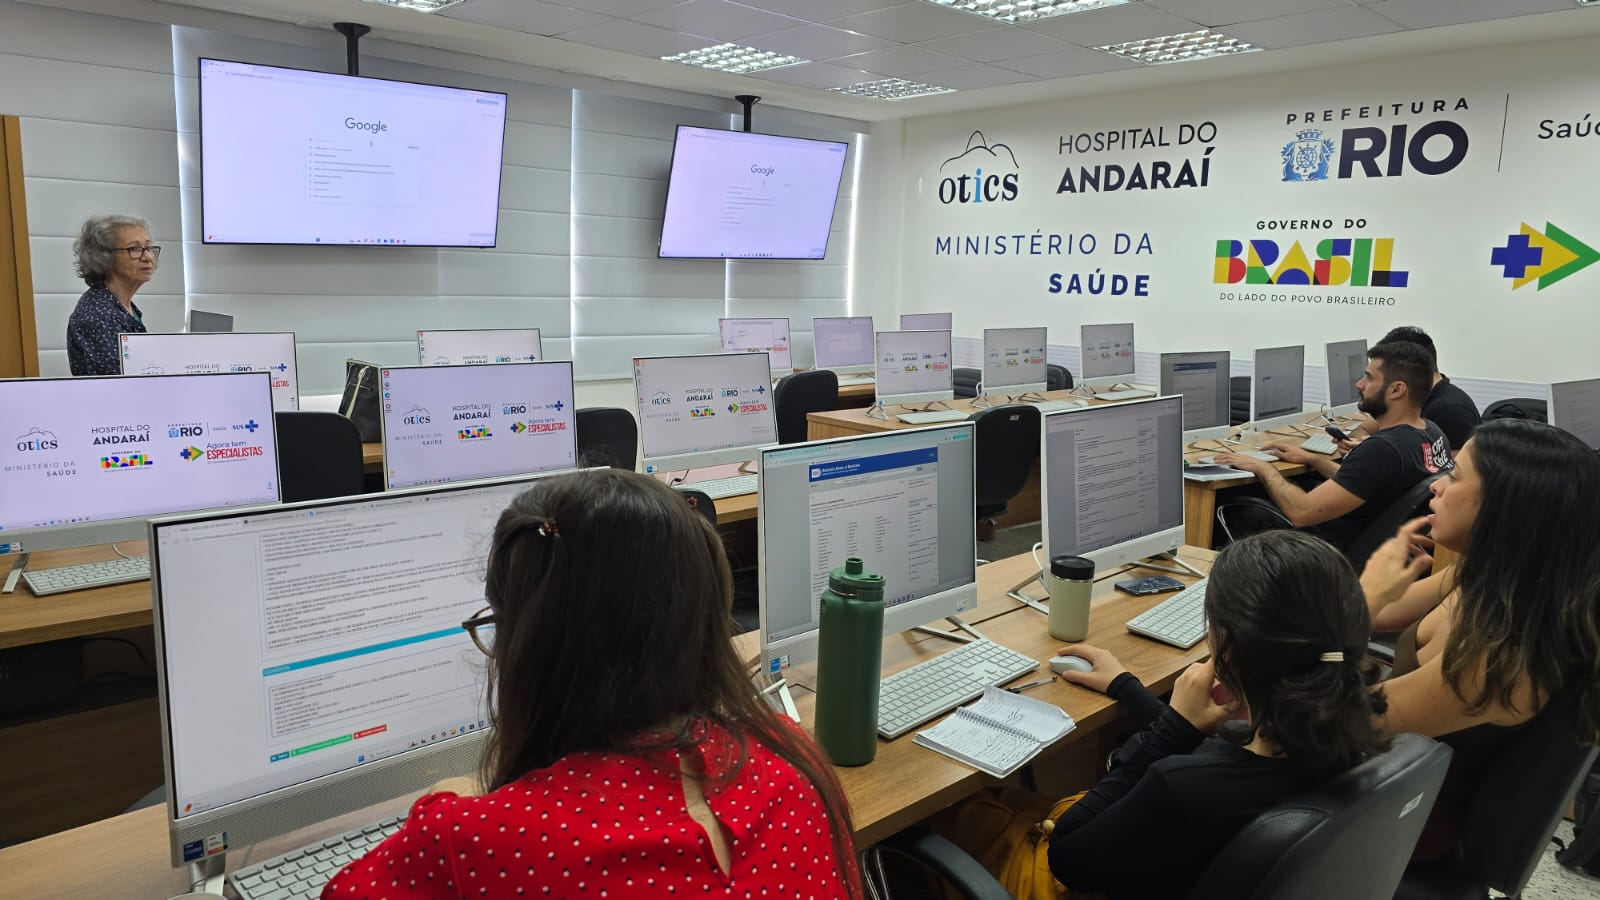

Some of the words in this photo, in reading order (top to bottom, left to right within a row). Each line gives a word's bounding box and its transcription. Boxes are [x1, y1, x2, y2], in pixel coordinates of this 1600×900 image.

[1286, 97, 1469, 125] PREFEITURA
[345, 117, 387, 134] Google
[1059, 127, 1170, 154] HOSPITAL
[1178, 121, 1217, 145] DO
[1338, 120, 1469, 179] RIO
[750, 164, 775, 176] Google
[1056, 146, 1216, 194] ANDARAÍ
[939, 168, 1019, 204] otics
[1256, 220, 1333, 230] GOVERNO
[1344, 219, 1367, 229] DO
[935, 229, 1097, 255] MINISTÉRIO
[1114, 233, 1152, 255] DA
[1213, 238, 1409, 288] BRASIL
[1048, 268, 1150, 297] SAÚDE
[1220, 292, 1235, 301] DO
[1238, 293, 1267, 302] LADO
[1271, 294, 1287, 302] DO
[1291, 295, 1322, 304] POVO
[1326, 296, 1396, 306] BRASILEIRO
[453, 409, 491, 420] ANDARAÍ
[511, 405, 527, 414] RIO
[403, 415, 431, 425] otics
[91, 425, 135, 434] HOSPITAL
[180, 426, 203, 437] RIO
[528, 422, 566, 433] ESPECIALISTAS
[17, 438, 58, 451] otics
[93, 431, 150, 445] ANDARAÍ
[206, 441, 229, 449] Agora
[206, 446, 263, 460] ESPECIALISTAS
[4, 461, 59, 471] MINISTÉRIO
[100, 454, 153, 469] BRASIL
[46, 469, 77, 477] SAÚDE
